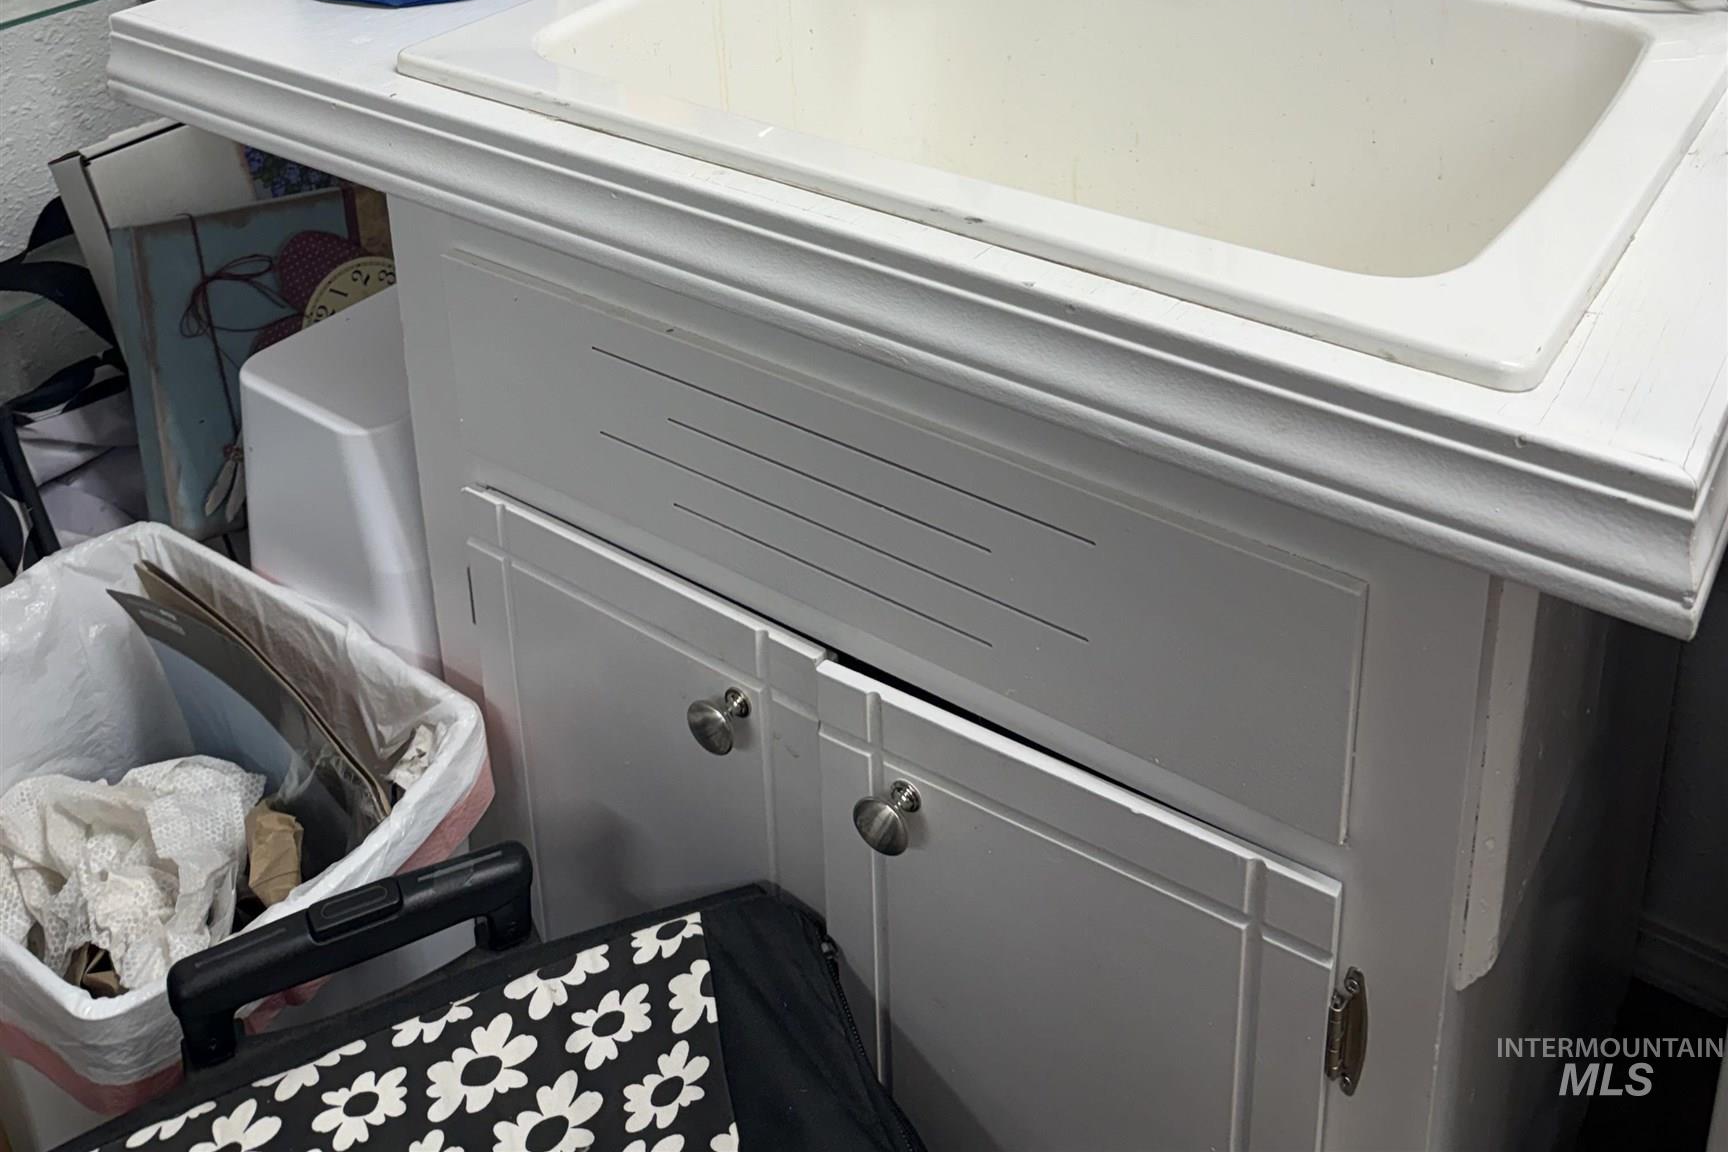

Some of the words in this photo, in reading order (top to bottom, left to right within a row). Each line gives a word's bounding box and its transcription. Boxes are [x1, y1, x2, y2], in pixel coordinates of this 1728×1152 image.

[352, 269, 370, 286] 2
[378, 269, 396, 285] 3
[329, 288, 348, 297] 1
